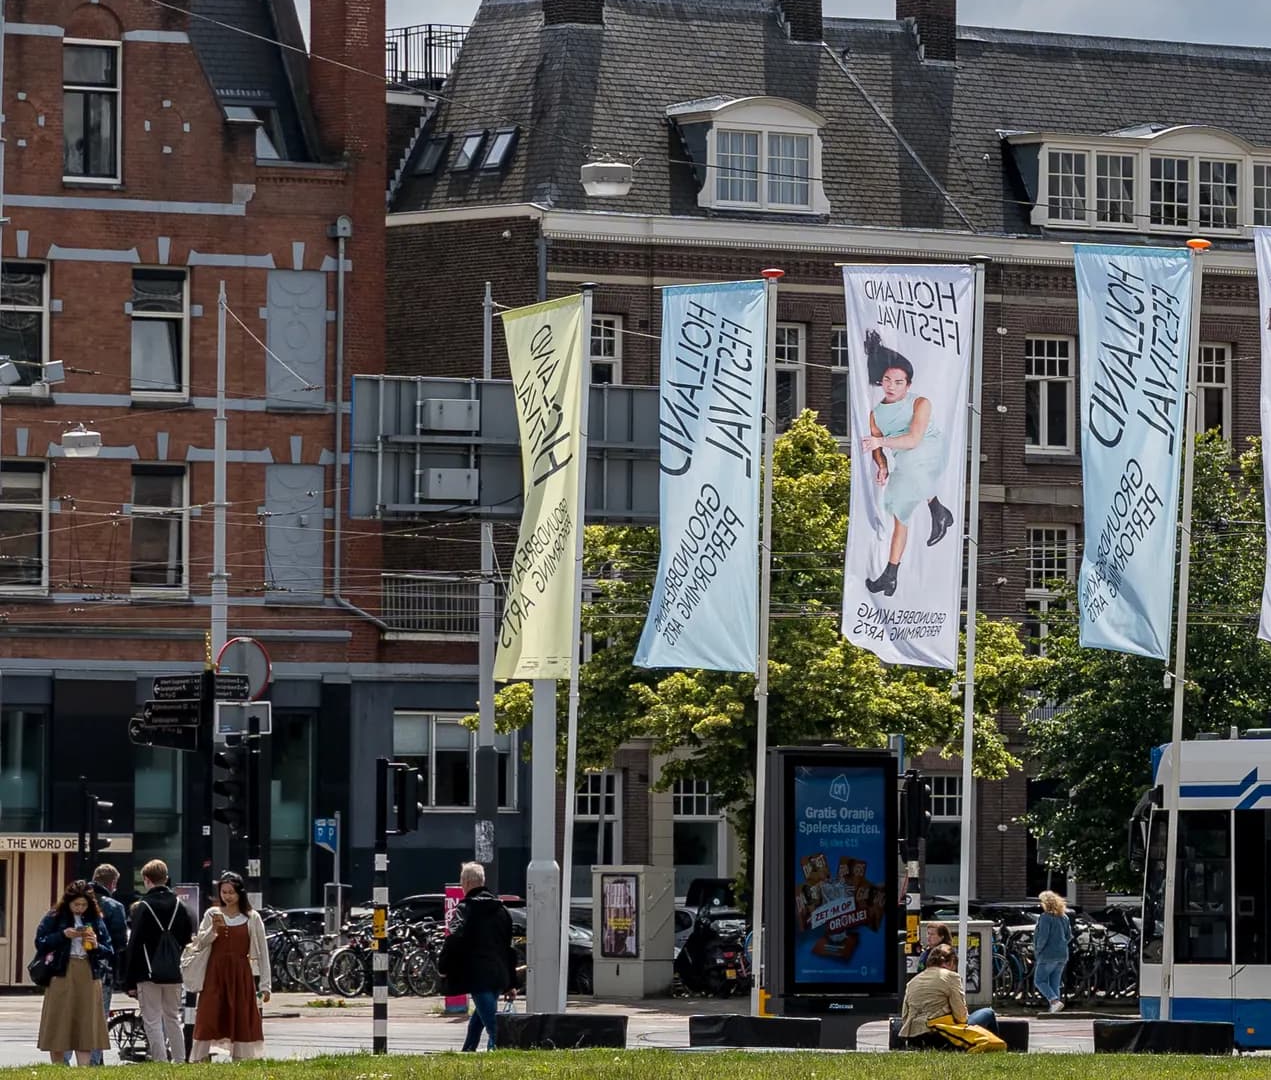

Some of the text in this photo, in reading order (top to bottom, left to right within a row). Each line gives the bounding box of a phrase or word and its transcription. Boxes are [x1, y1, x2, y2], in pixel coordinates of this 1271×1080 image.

[805, 806, 874, 822] Gratis Oranje
[799, 821, 881, 835] Spelerskaarten.
[7, 838, 78, 848] THE WORD OF
[816, 911, 829, 920] ZET
[841, 901, 852, 910] OP
